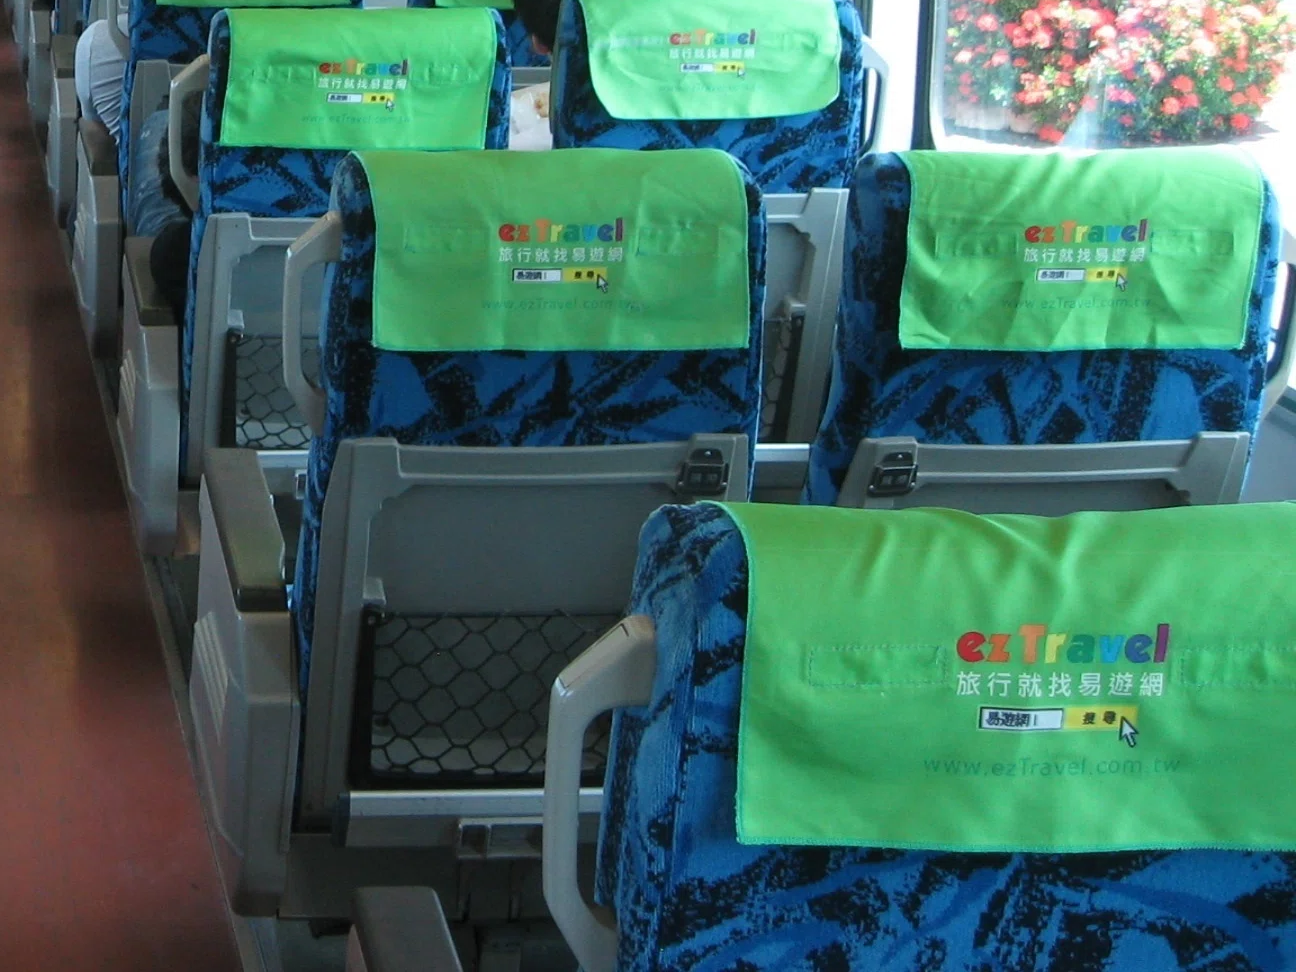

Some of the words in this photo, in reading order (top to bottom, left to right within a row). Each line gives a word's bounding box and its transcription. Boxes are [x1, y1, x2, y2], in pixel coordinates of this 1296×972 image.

[956, 671, 1164, 698] 旅行就找易遊網
